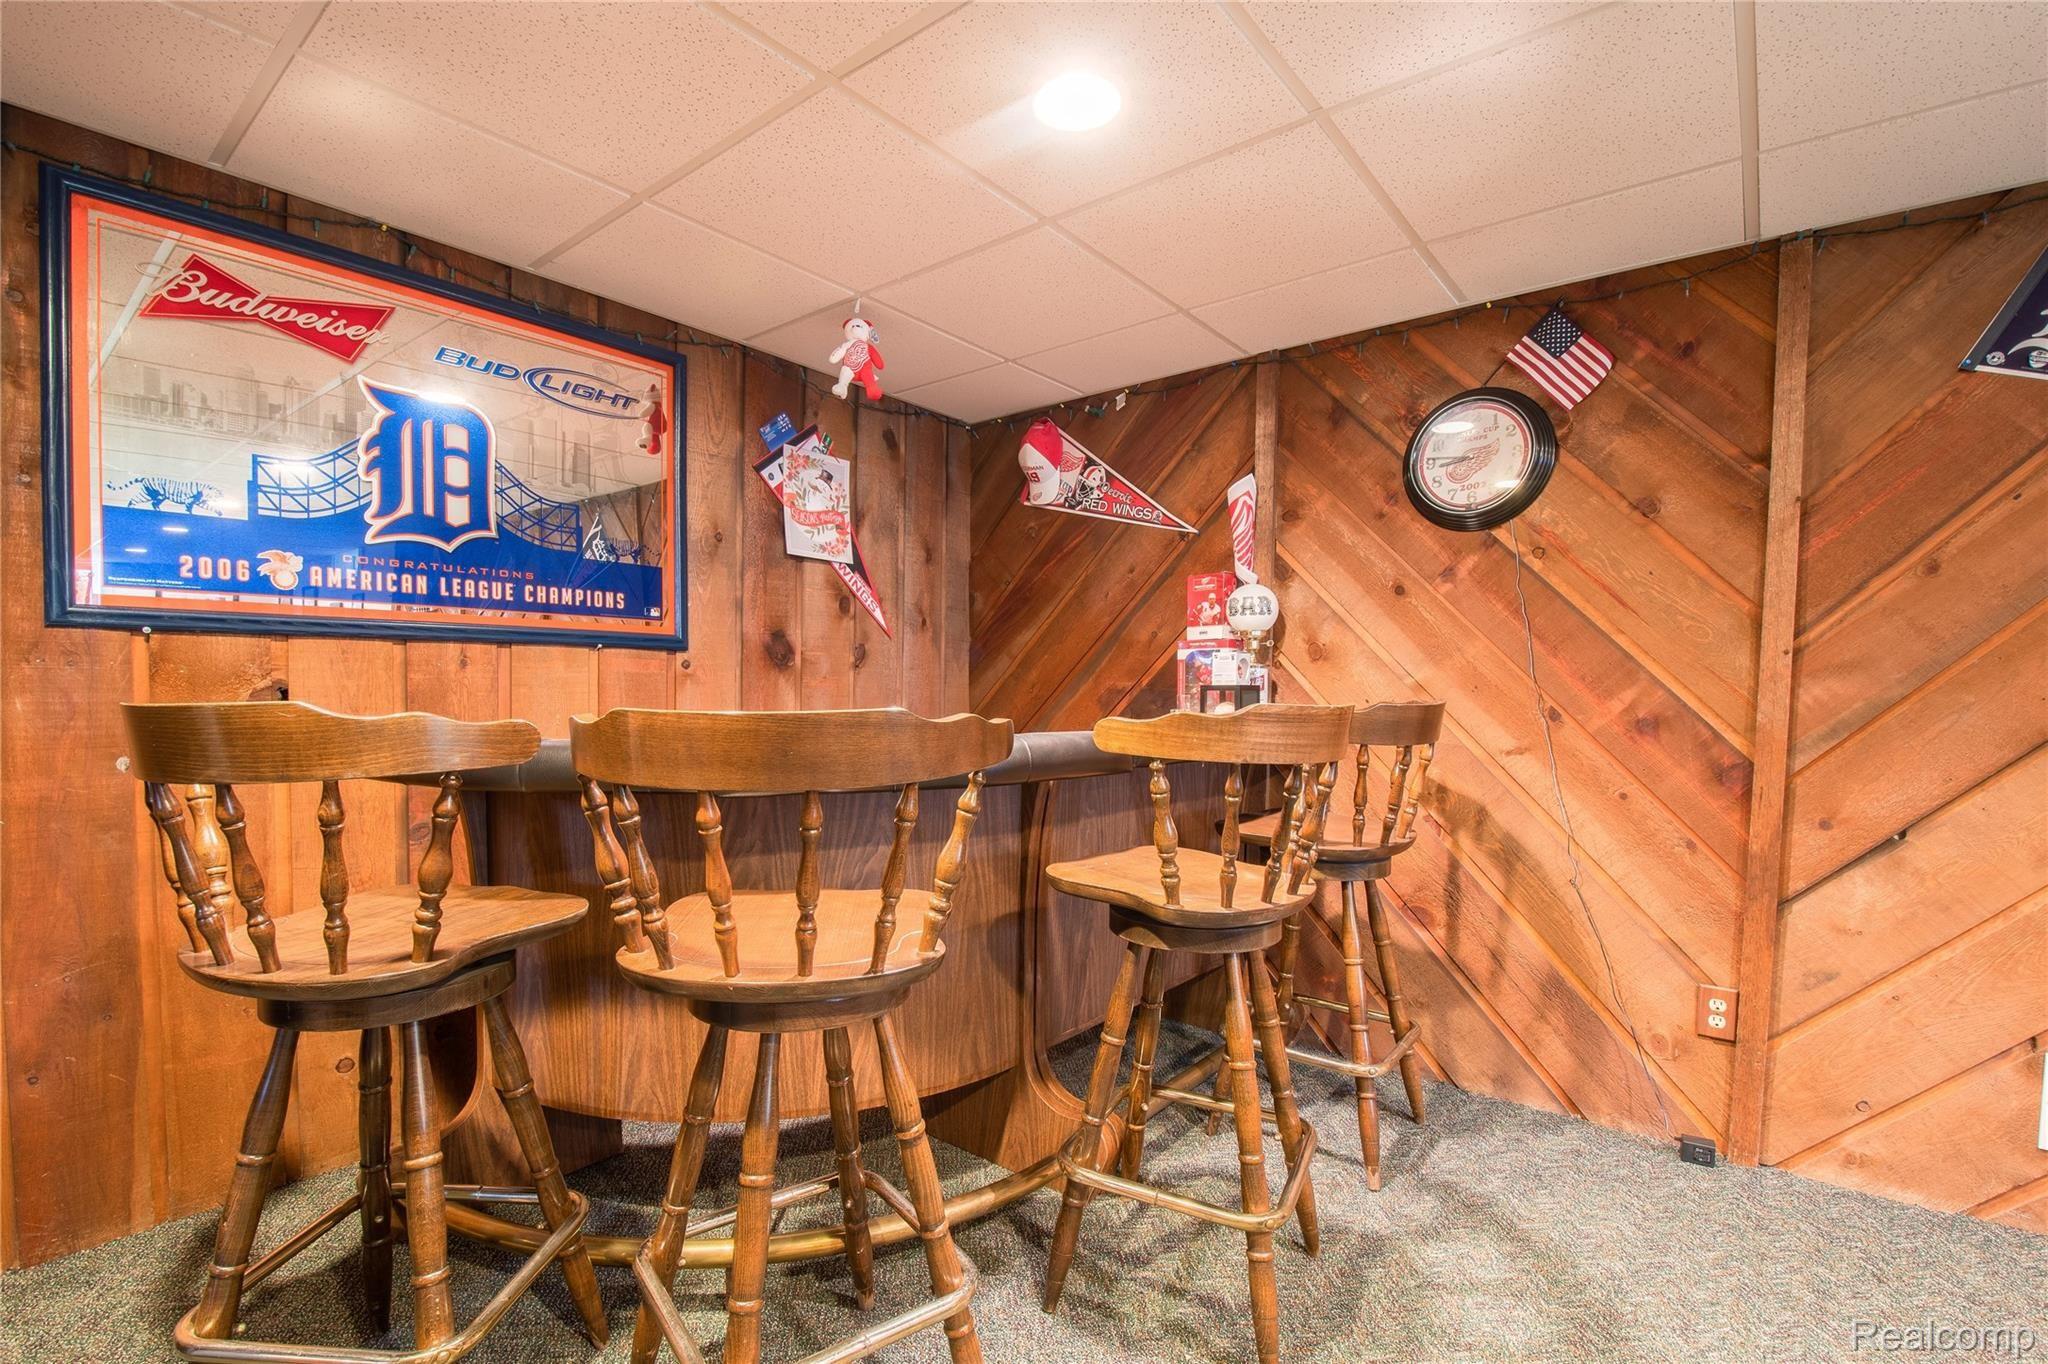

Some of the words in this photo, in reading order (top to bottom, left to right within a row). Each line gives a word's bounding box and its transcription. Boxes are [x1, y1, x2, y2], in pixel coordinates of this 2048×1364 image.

[143, 265, 392, 345] Budweiser
[434, 345, 522, 381] BUD
[539, 373, 640, 410] LIGHT
[1505, 424, 1517, 438] 2
[1425, 458, 1436, 470] 9
[1026, 471, 1041, 482] 19
[1432, 475, 1443, 489] 8
[1448, 488, 1458, 501] 7
[1466, 490, 1477, 503] 6
[1083, 499, 1108, 512] RED
[1112, 502, 1153, 519] WINGS
[342, 554, 535, 580] CONGRATULATIONS
[179, 555, 250, 581] 2006
[309, 566, 428, 595] AMERICAN
[440, 577, 514, 601] LEAGUE
[524, 584, 625, 609] CHAMPIONS
[838, 562, 878, 613] WINGS
[1228, 595, 1273, 617] BAR
